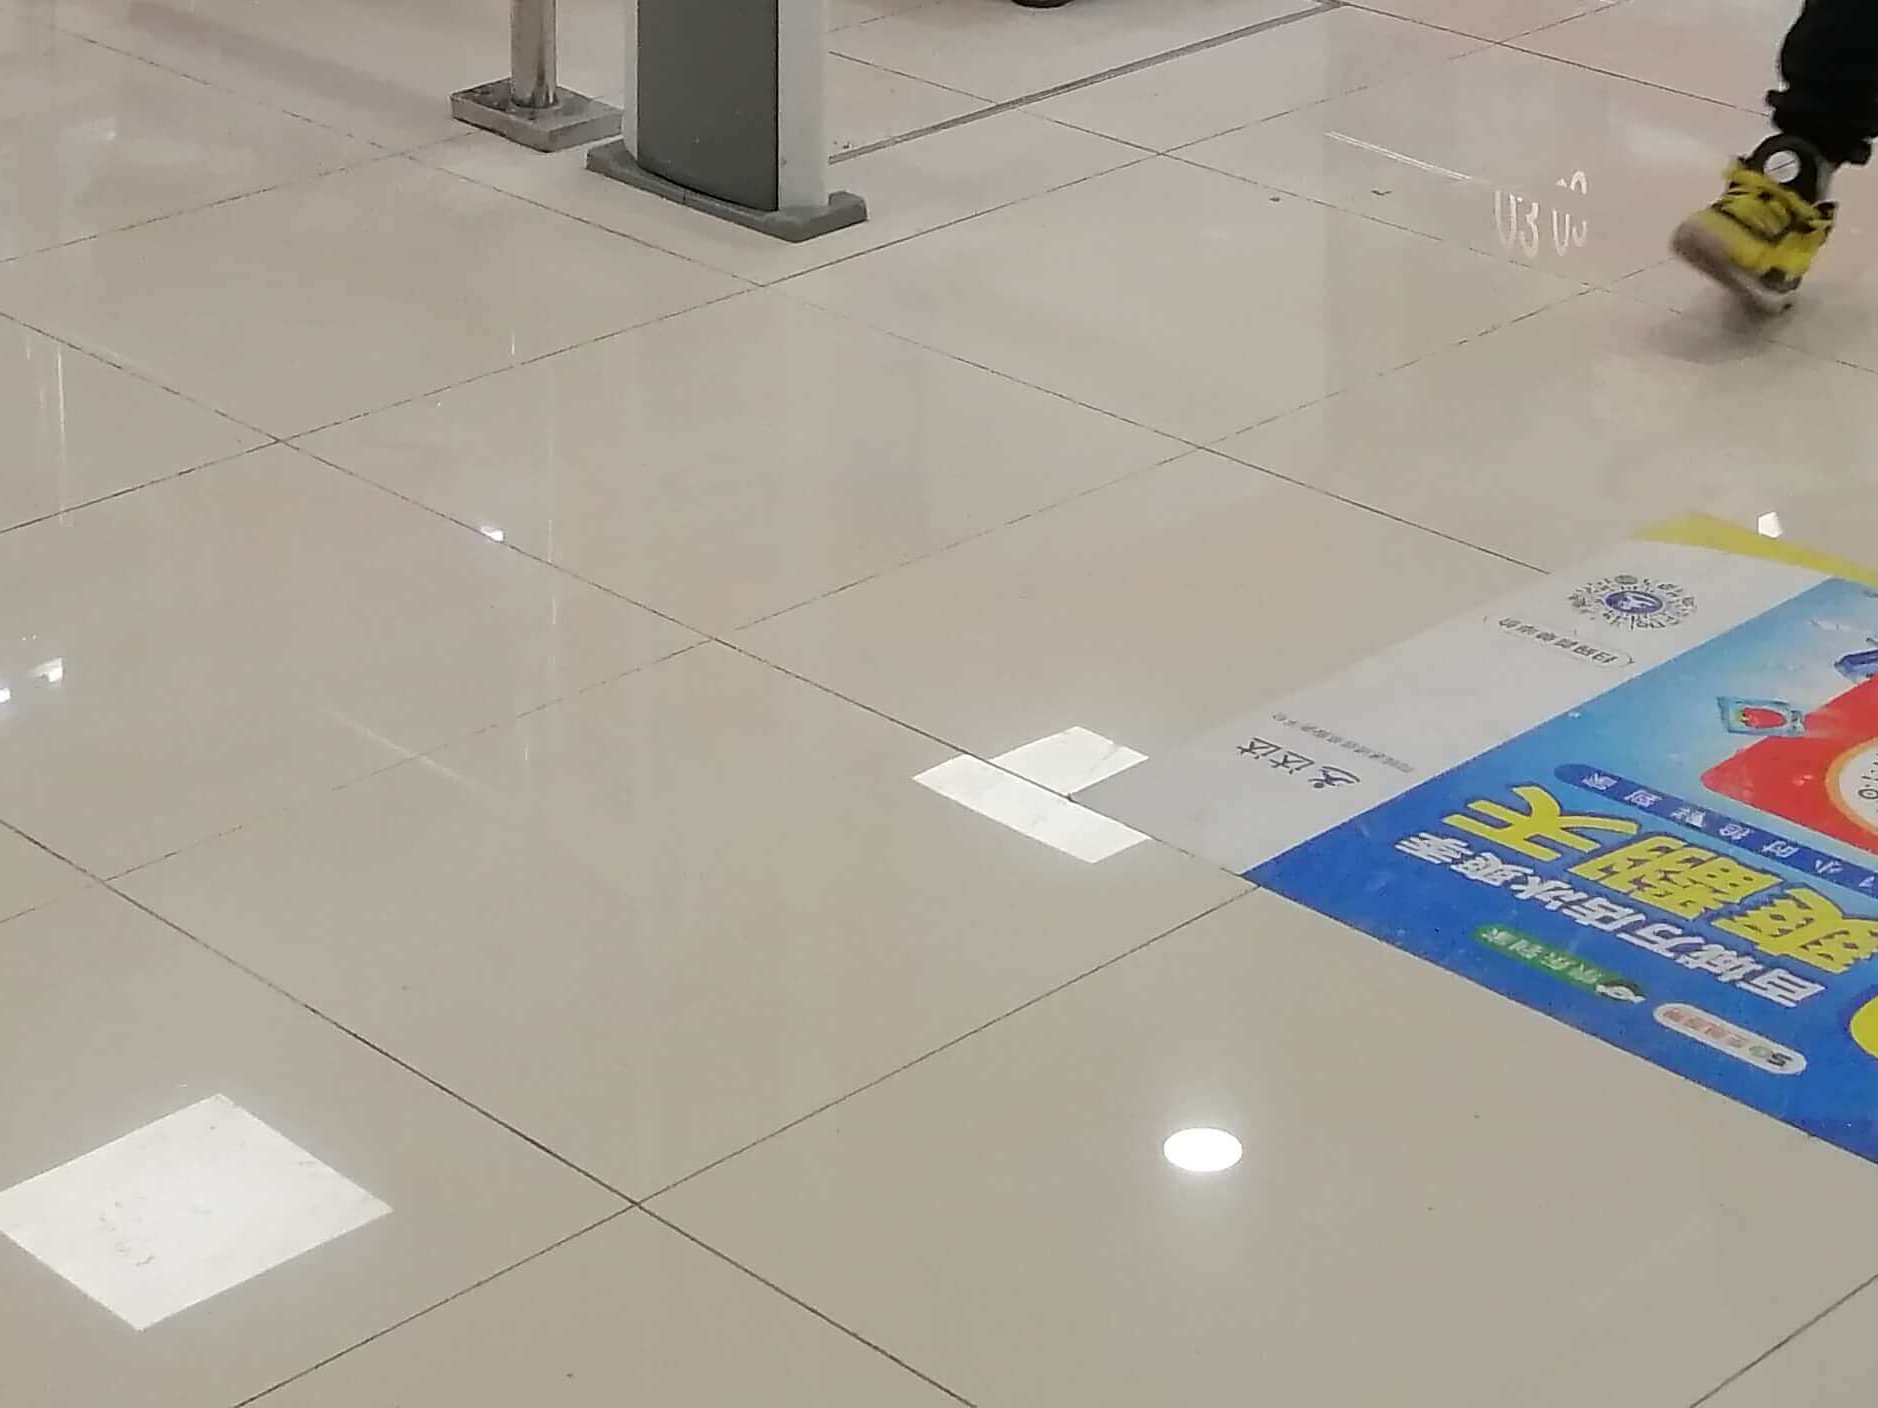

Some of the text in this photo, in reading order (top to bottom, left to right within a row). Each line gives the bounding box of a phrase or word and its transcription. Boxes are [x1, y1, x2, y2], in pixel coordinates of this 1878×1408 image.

[1394, 830, 1827, 1009] 百城万店冰爽季
